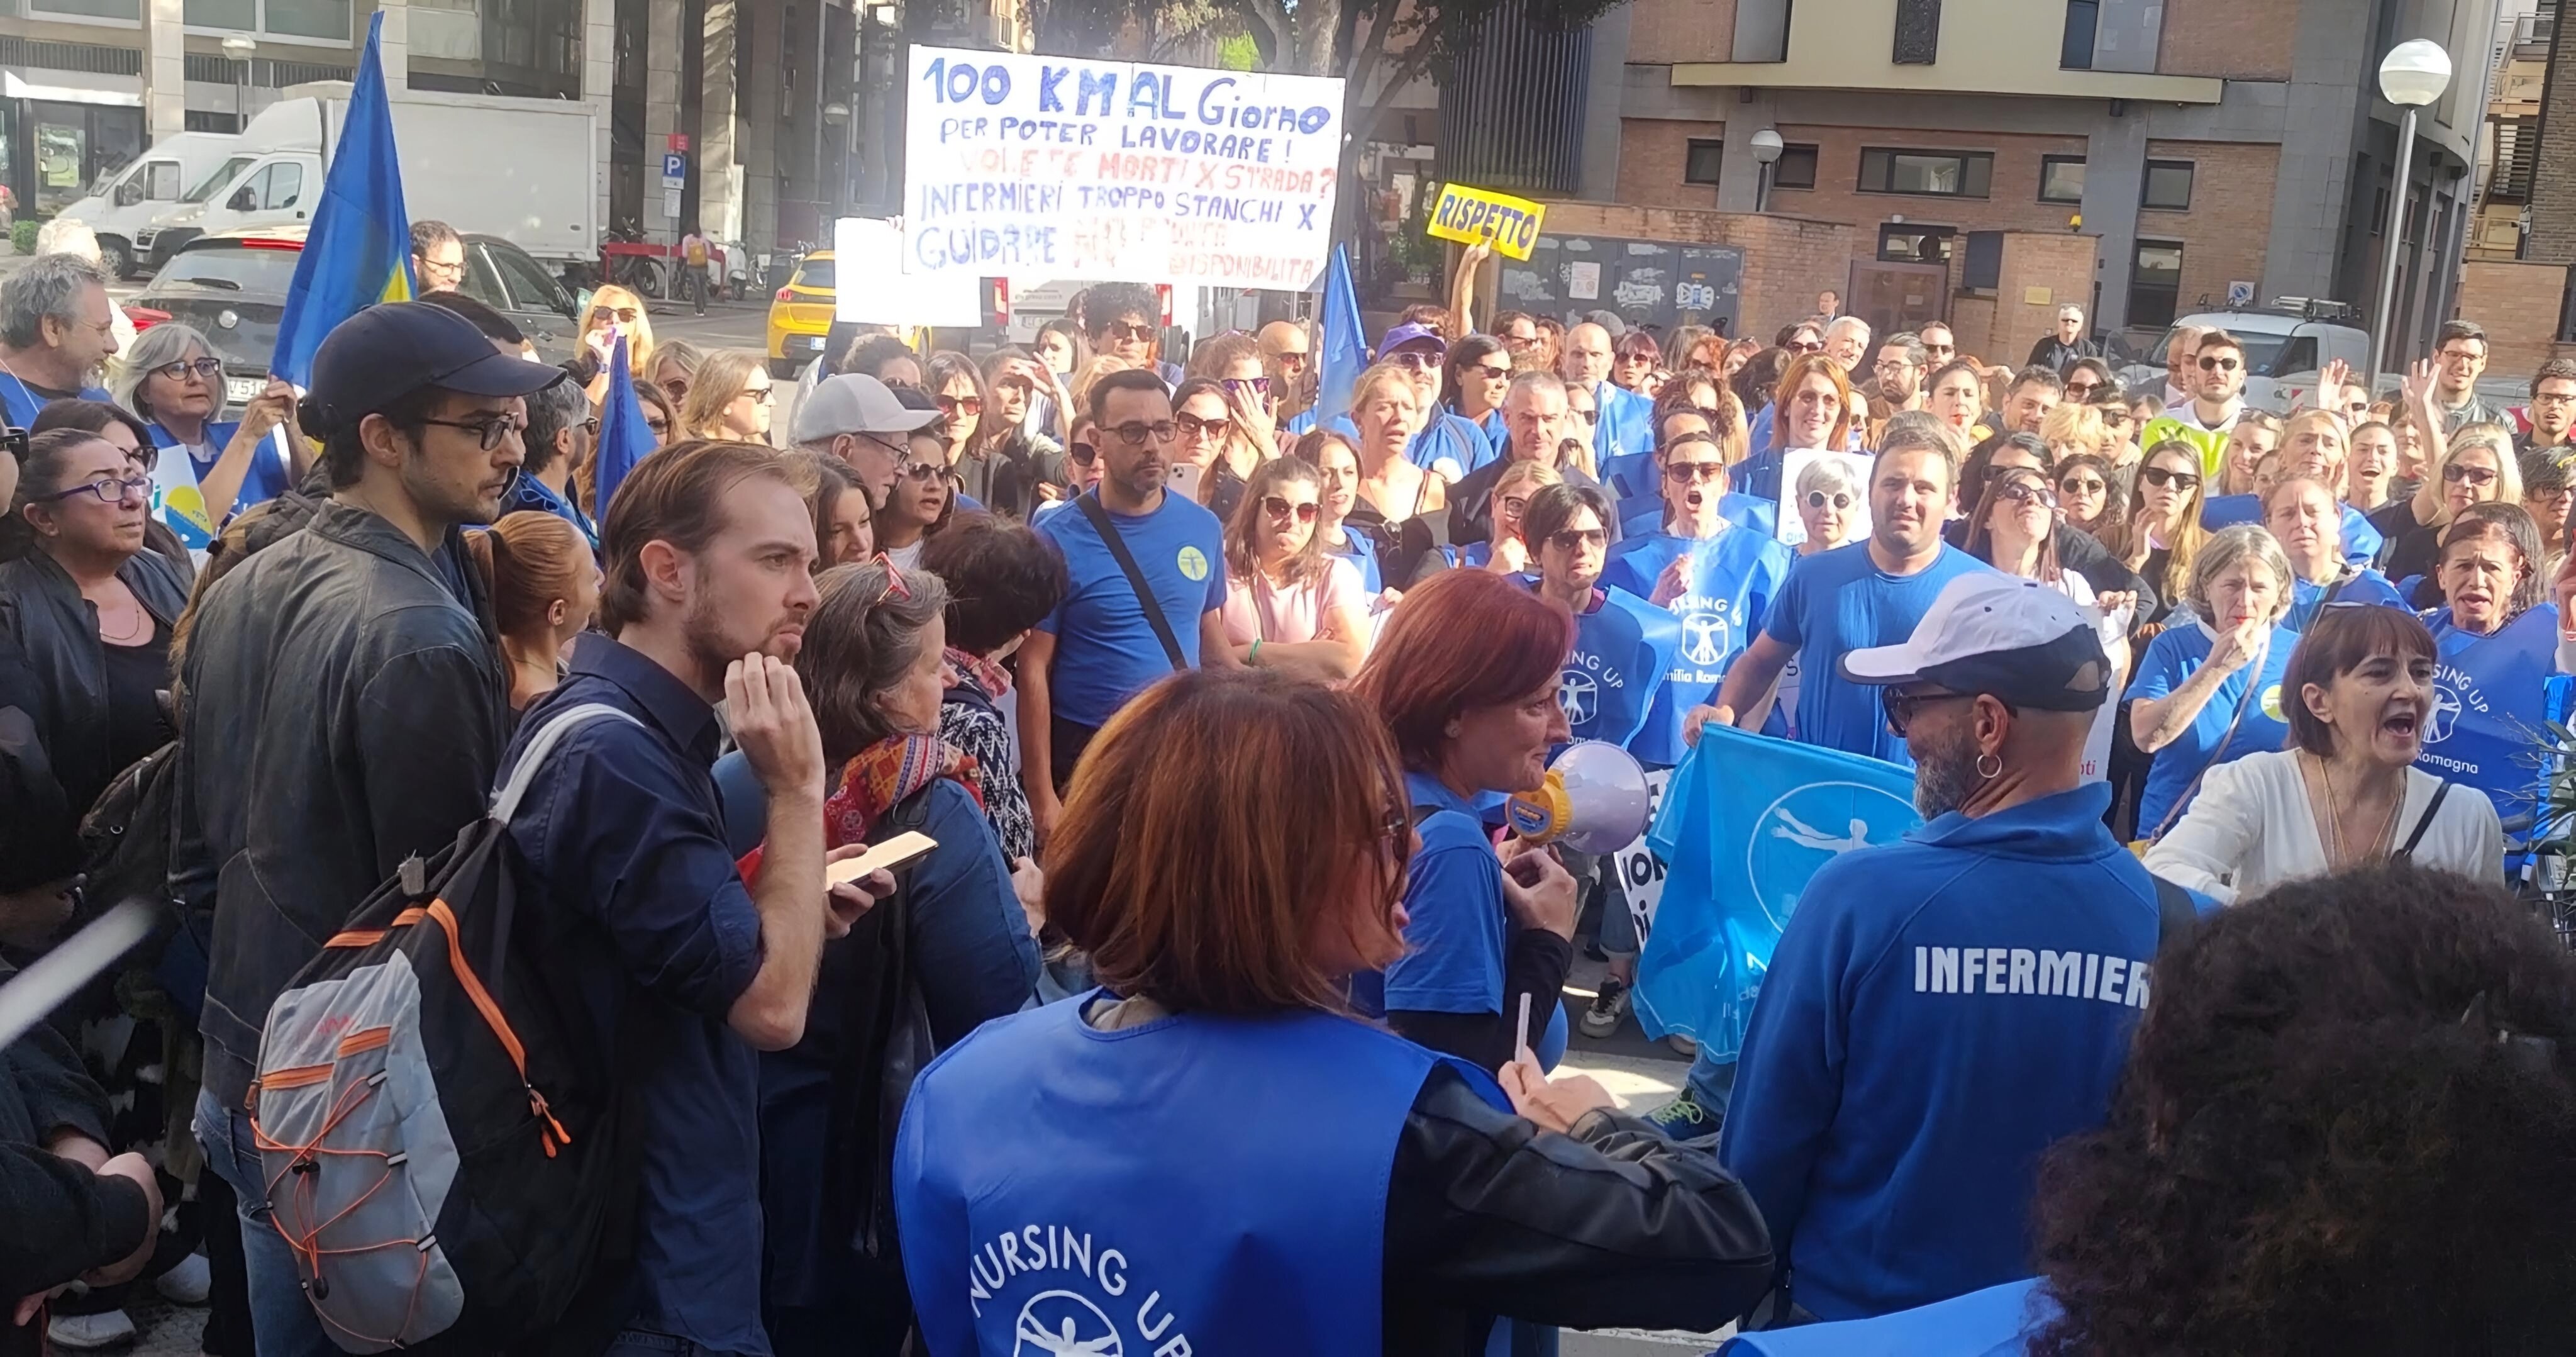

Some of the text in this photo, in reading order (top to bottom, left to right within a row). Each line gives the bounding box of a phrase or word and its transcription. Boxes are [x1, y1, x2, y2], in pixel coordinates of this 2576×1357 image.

[923, 57, 1011, 105] 100
[1197, 77, 1331, 135] Giorno
[940, 117, 988, 143] PER
[1000, 117, 1097, 145] POTER
[1121, 125, 1272, 164] LAVORARE
[667, 156, 680, 175] P
[1098, 152, 1189, 184] MORTI
[1195, 162, 1218, 188] X
[921, 178, 1316, 230] INFERMIERI TROPPO STANCHI X
[1436, 194, 1536, 249] RISPETTO
[1603, 667, 1623, 688] UP
[2468, 690, 2489, 712] UP
[970, 1225, 1128, 1318] NURSING
